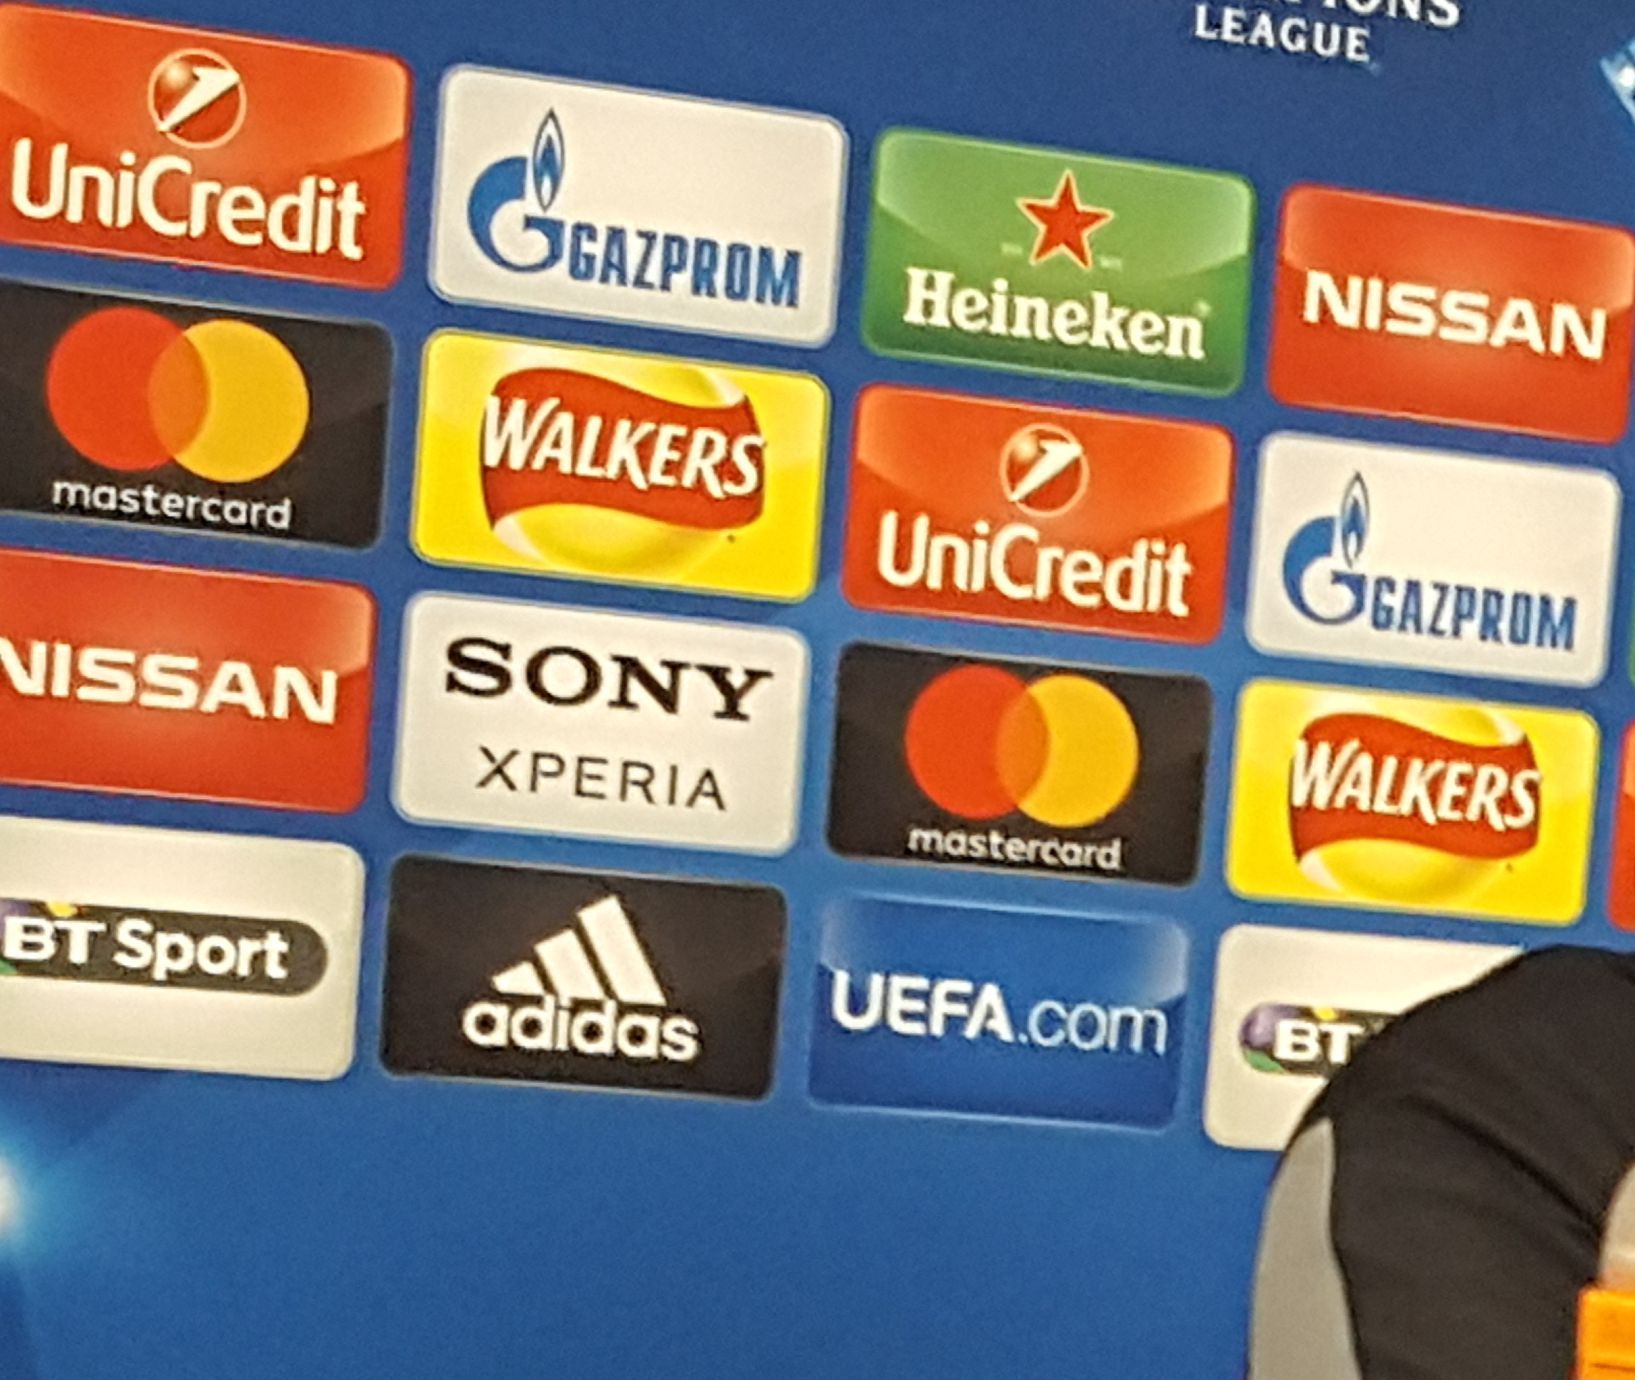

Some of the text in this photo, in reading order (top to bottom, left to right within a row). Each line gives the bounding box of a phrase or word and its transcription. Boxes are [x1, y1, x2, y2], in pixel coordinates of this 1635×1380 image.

[1194, 3, 1371, 62] LEAGUE
[11, 137, 367, 263] UniCredit
[568, 231, 801, 309] GAZPROM
[903, 266, 1205, 360] Heineken
[1303, 270, 1606, 361] NISSAN
[484, 394, 767, 500] WALKERS
[52, 478, 292, 531] mastercard
[877, 511, 1191, 617] UniCredit
[1371, 575, 1577, 652] GAZPROM
[0, 638, 338, 726] NISSAN
[446, 637, 774, 722] SONY
[477, 745, 727, 812] XPERIA
[1291, 737, 1542, 832] WALKERS
[907, 825, 1123, 871] mastercard
[2, 918, 290, 981] BT Sport
[463, 994, 702, 1063] adidas
[831, 970, 1168, 1056] UEFA.com
[1274, 1019, 1366, 1064] BT
